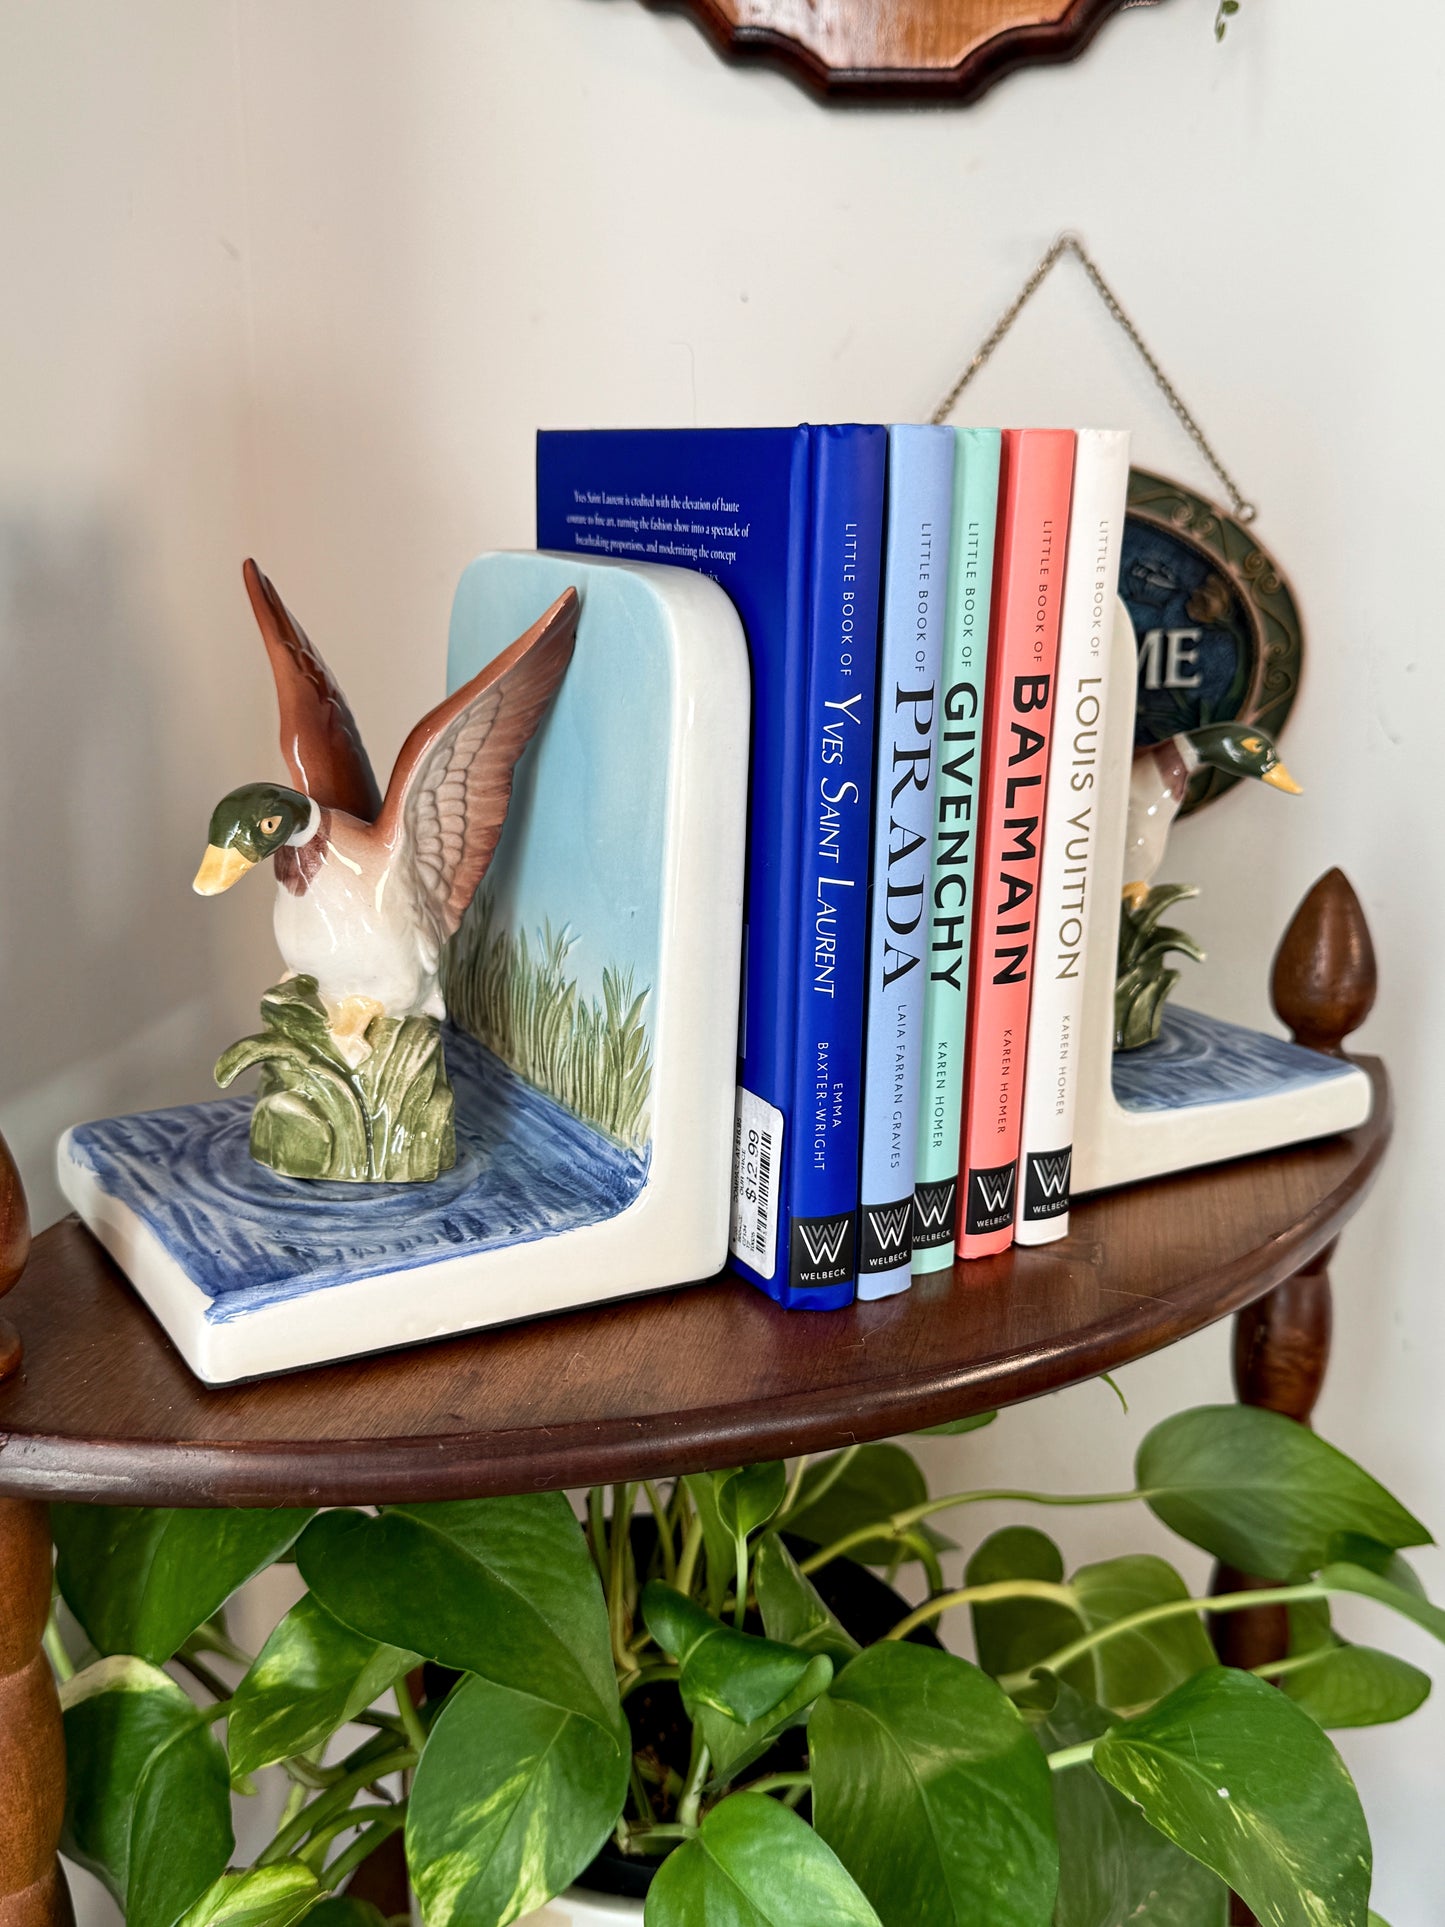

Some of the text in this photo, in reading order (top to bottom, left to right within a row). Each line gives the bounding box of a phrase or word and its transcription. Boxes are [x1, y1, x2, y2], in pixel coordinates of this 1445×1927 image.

[602, 491, 624, 506] Laurent
[625, 494, 630, 506] is
[631, 493, 655, 507] credited
[656, 494, 670, 508] with
[671, 495, 681, 509] the
[682, 495, 711, 511] elevation
[712, 497, 721, 511] of
[721, 497, 740, 513] haute
[617, 516, 639, 533] turning
[640, 516, 649, 530] the
[650, 517, 672, 531] fashion
[673, 518, 690, 532] show
[691, 520, 704, 534] into
[705, 525, 710, 535] a
[711, 522, 741, 540] spectacle
[741, 523, 750, 538] of
[646, 539, 658, 553] and
[658, 541, 698, 561] modernizing
[699, 544, 709, 558] the
[710, 549, 736, 565] concept
[843, 523, 857, 582] LITTLE
[841, 592, 855, 644] BOOK
[840, 653, 853, 676] OF
[881, 523, 935, 993] LITTLE BOOK OF PRADA
[930, 523, 979, 992] LITTLE BOOK OF GIVENCHY
[993, 521, 1053, 985] LITTLE BOOK OF BALMAIN
[1055, 521, 1109, 980] LITTLE BOOK OF LOUIS VUITTON
[890, 1004, 908, 1169] LAIA FARRAN GRAVES
[997, 1029, 1013, 1134] KAREN HOMER
[1055, 1015, 1071, 1116] KAREN HOMER
[813, 1042, 829, 1171] BAXTER-WRIGHT
[832, 1083, 843, 1128] EMMA
[932, 1041, 948, 1149] KAREN HOMER
[745, 1129, 760, 1203] $12.99
[976, 1214, 1011, 1228] WELBECK
[1032, 1199, 1069, 1214] WELBECK
[869, 1251, 908, 1267] WELBECK
[912, 1229, 951, 1243] WELBECK
[800, 1267, 847, 1281] WELBECK
